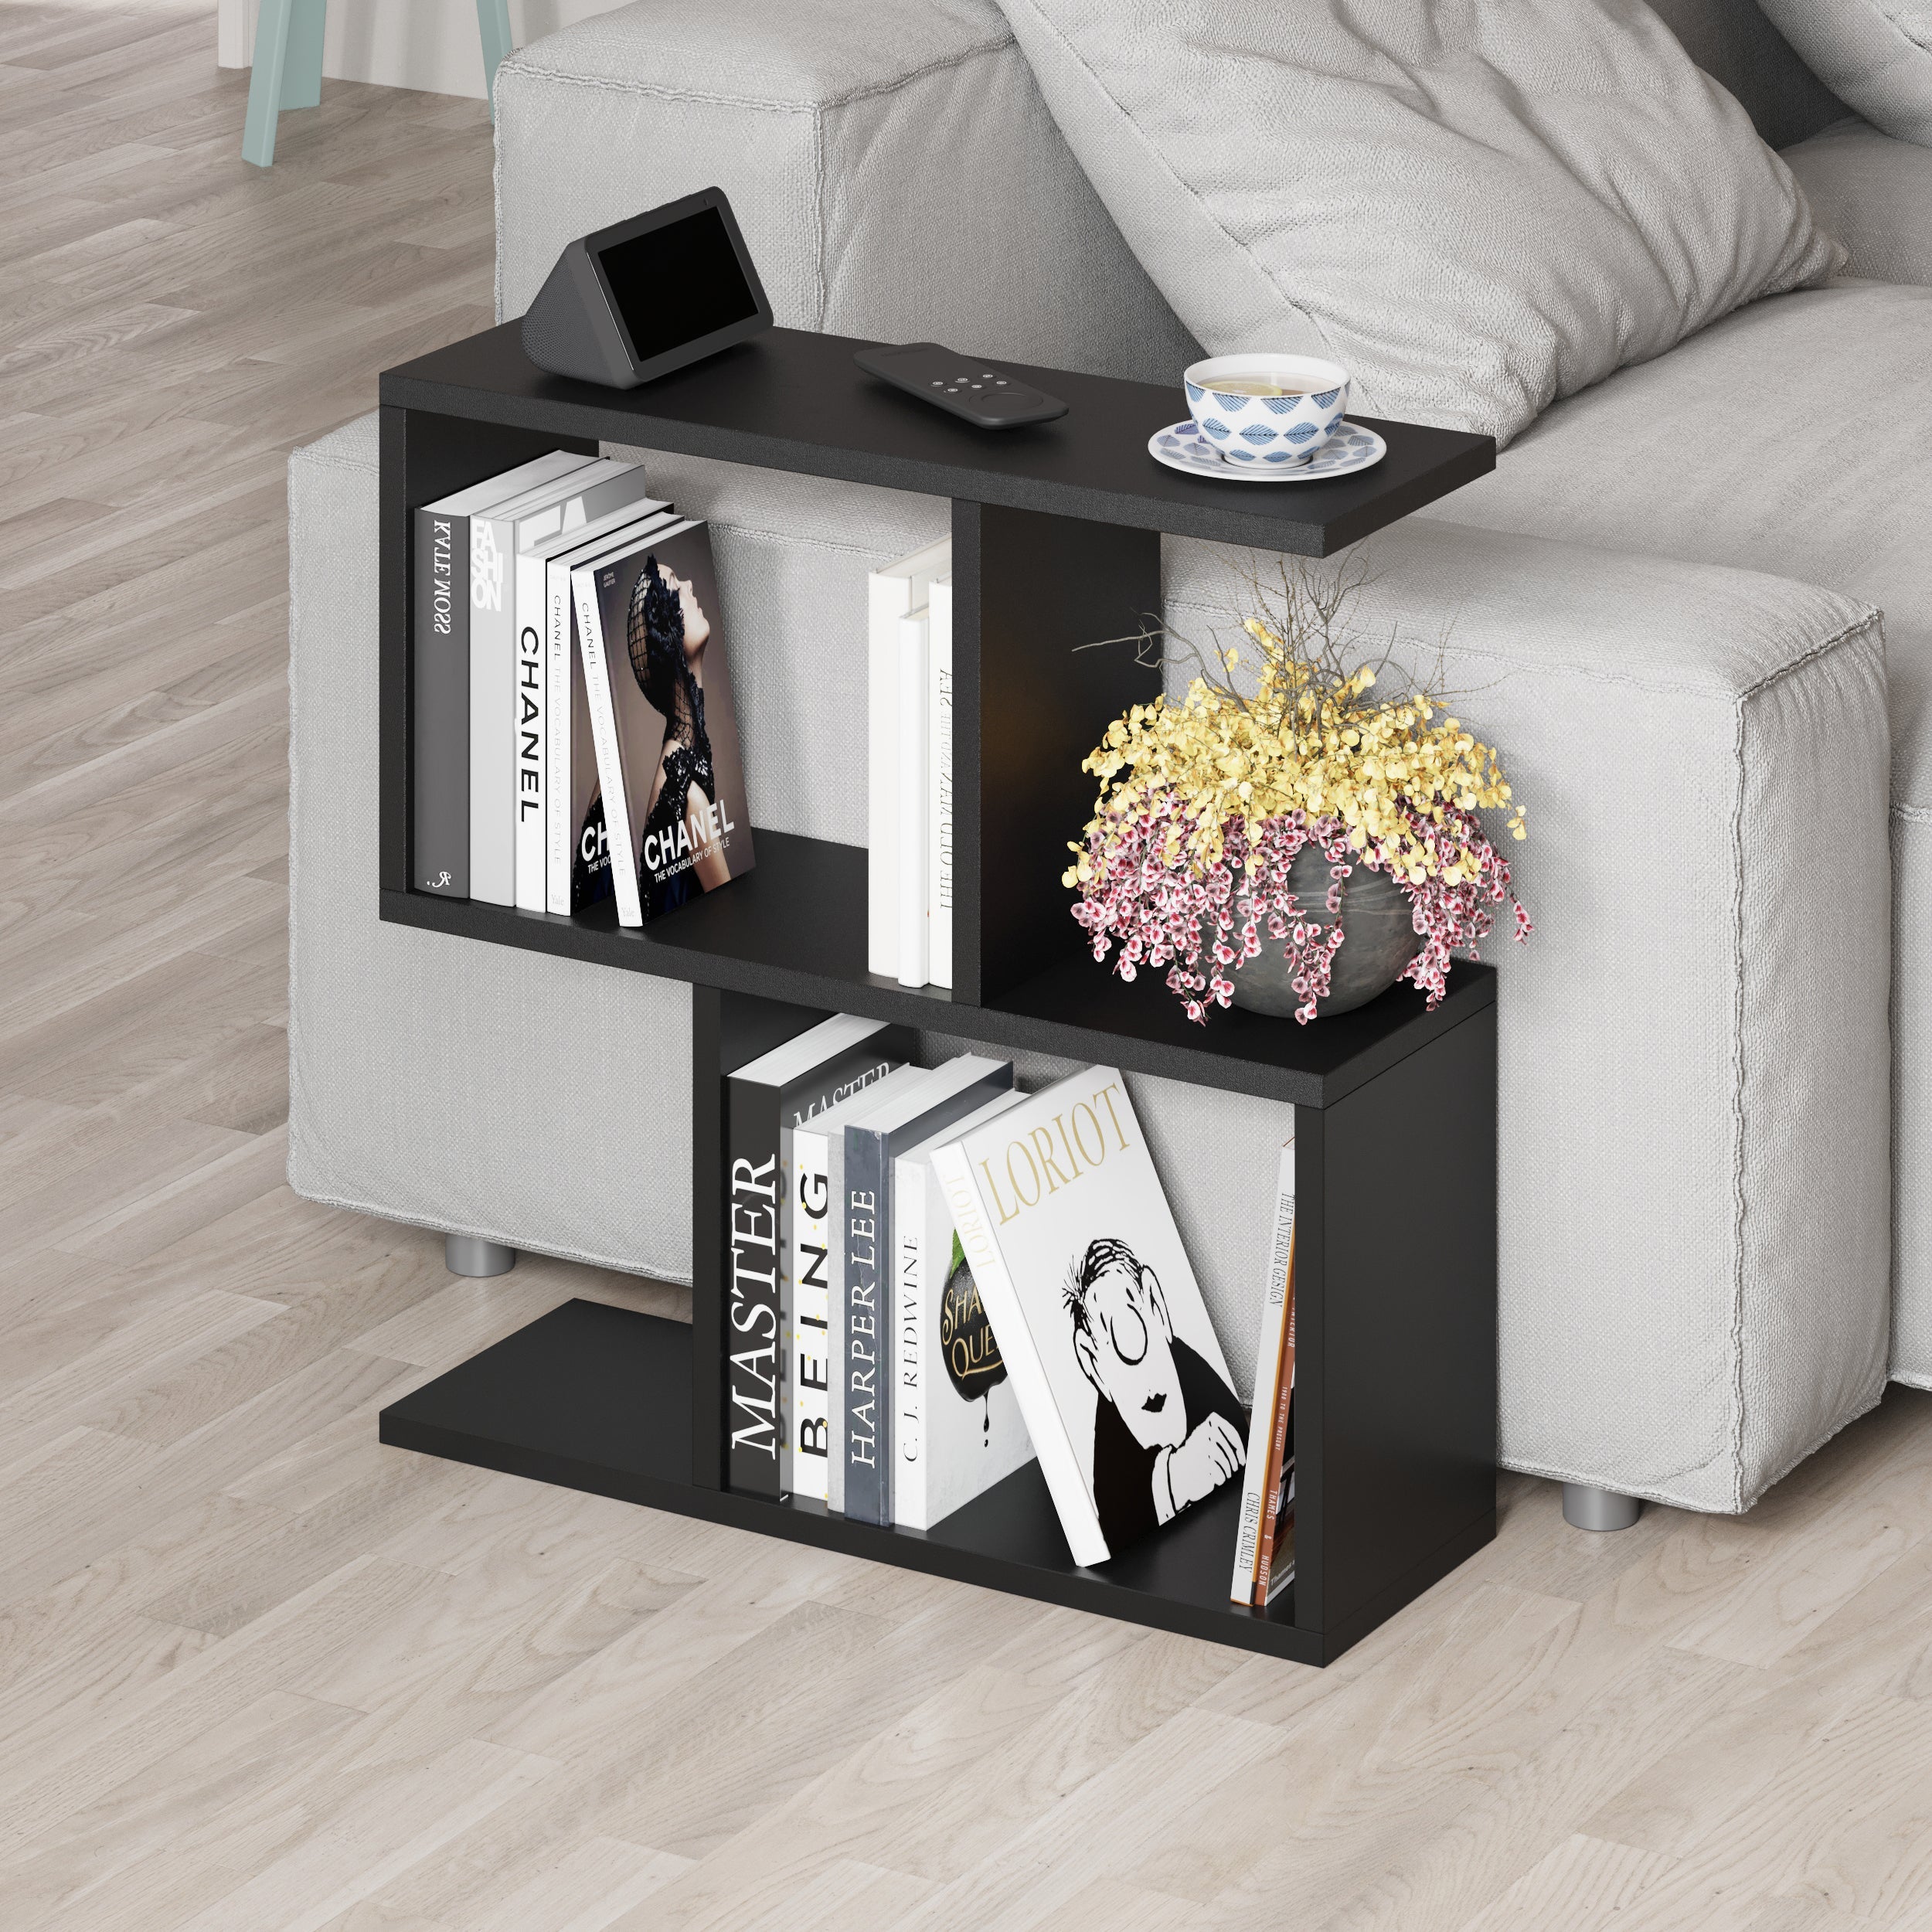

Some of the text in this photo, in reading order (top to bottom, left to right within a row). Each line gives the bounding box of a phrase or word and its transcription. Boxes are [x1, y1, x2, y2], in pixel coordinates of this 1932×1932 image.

[521, 626, 539, 822] CHANEL
[582, 603, 597, 669] CHANEL
[597, 706, 616, 804] VOCABULARY
[554, 798, 562, 817] OF
[644, 799, 735, 871] CHANEL
[587, 860, 599, 874] THE
[654, 837, 730, 883] THE VOCABULARY OF STYLE
[978, 1082, 1131, 1226] LORIOT
[944, 1174, 996, 1268] LORIOT
[1280, 1192, 1295, 1214] THE
[1274, 1214, 1293, 1266] INTERIOR
[730, 1154, 776, 1460] MASTER
[800, 1173, 828, 1458] BEING
[852, 1190, 876, 1468] HARPER LEE
[942, 1285, 985, 1345] SHA
[903, 1236, 920, 1462] C. J. REDWINE
[952, 1324, 1003, 1381] QUE
[1275, 1427, 1284, 1451] PRESENT
[1244, 1492, 1260, 1526] CHRIS
[1267, 1490, 1277, 1520] THAMES
[1259, 1555, 1270, 1587] HUDSON
